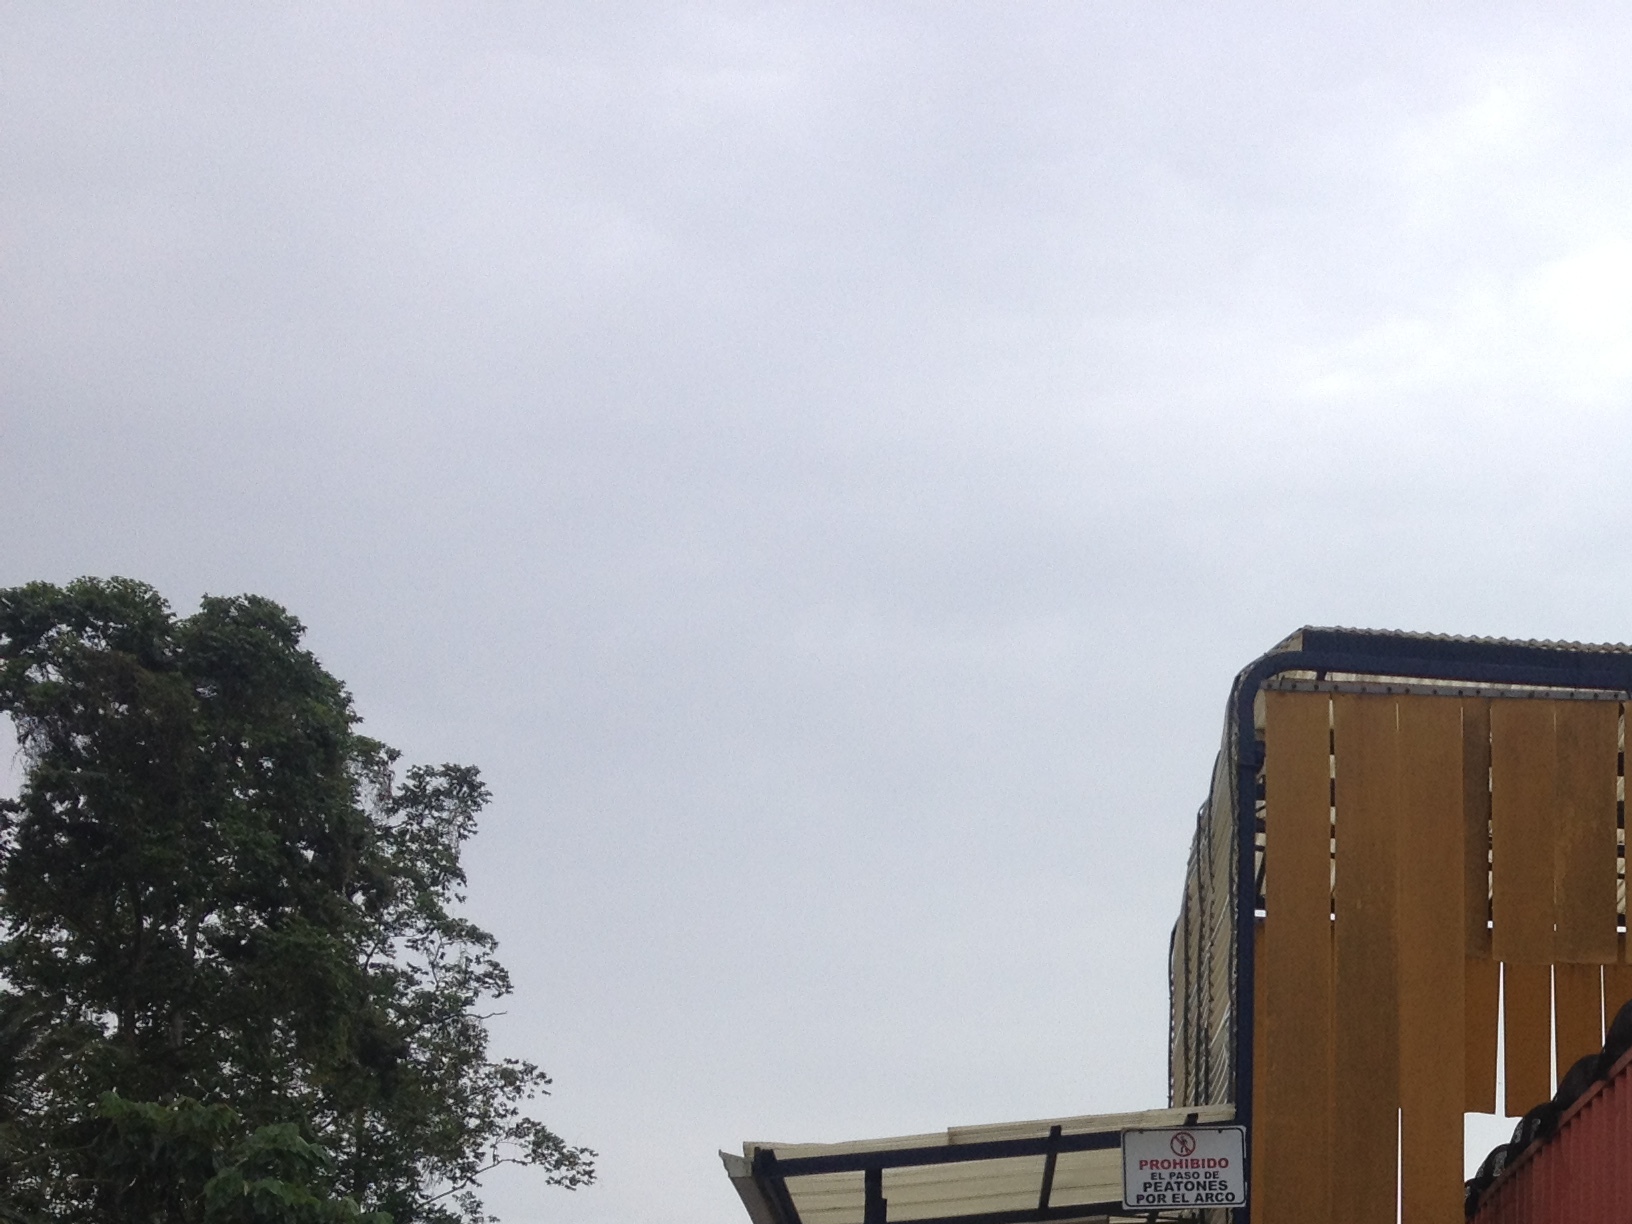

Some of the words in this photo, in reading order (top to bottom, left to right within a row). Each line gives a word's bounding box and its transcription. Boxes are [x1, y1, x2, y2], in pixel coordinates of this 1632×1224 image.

[1139, 1157, 1229, 1170] PROHIBIDO
[1150, 1172, 1165, 1181] EL
[1169, 1171, 1200, 1180] PASO
[1204, 1170, 1220, 1179] DE
[1143, 1180, 1228, 1193] PEATONES
[1136, 1194, 1167, 1204] POR
[1172, 1193, 1189, 1203] EL
[1194, 1192, 1236, 1203] ARCO
